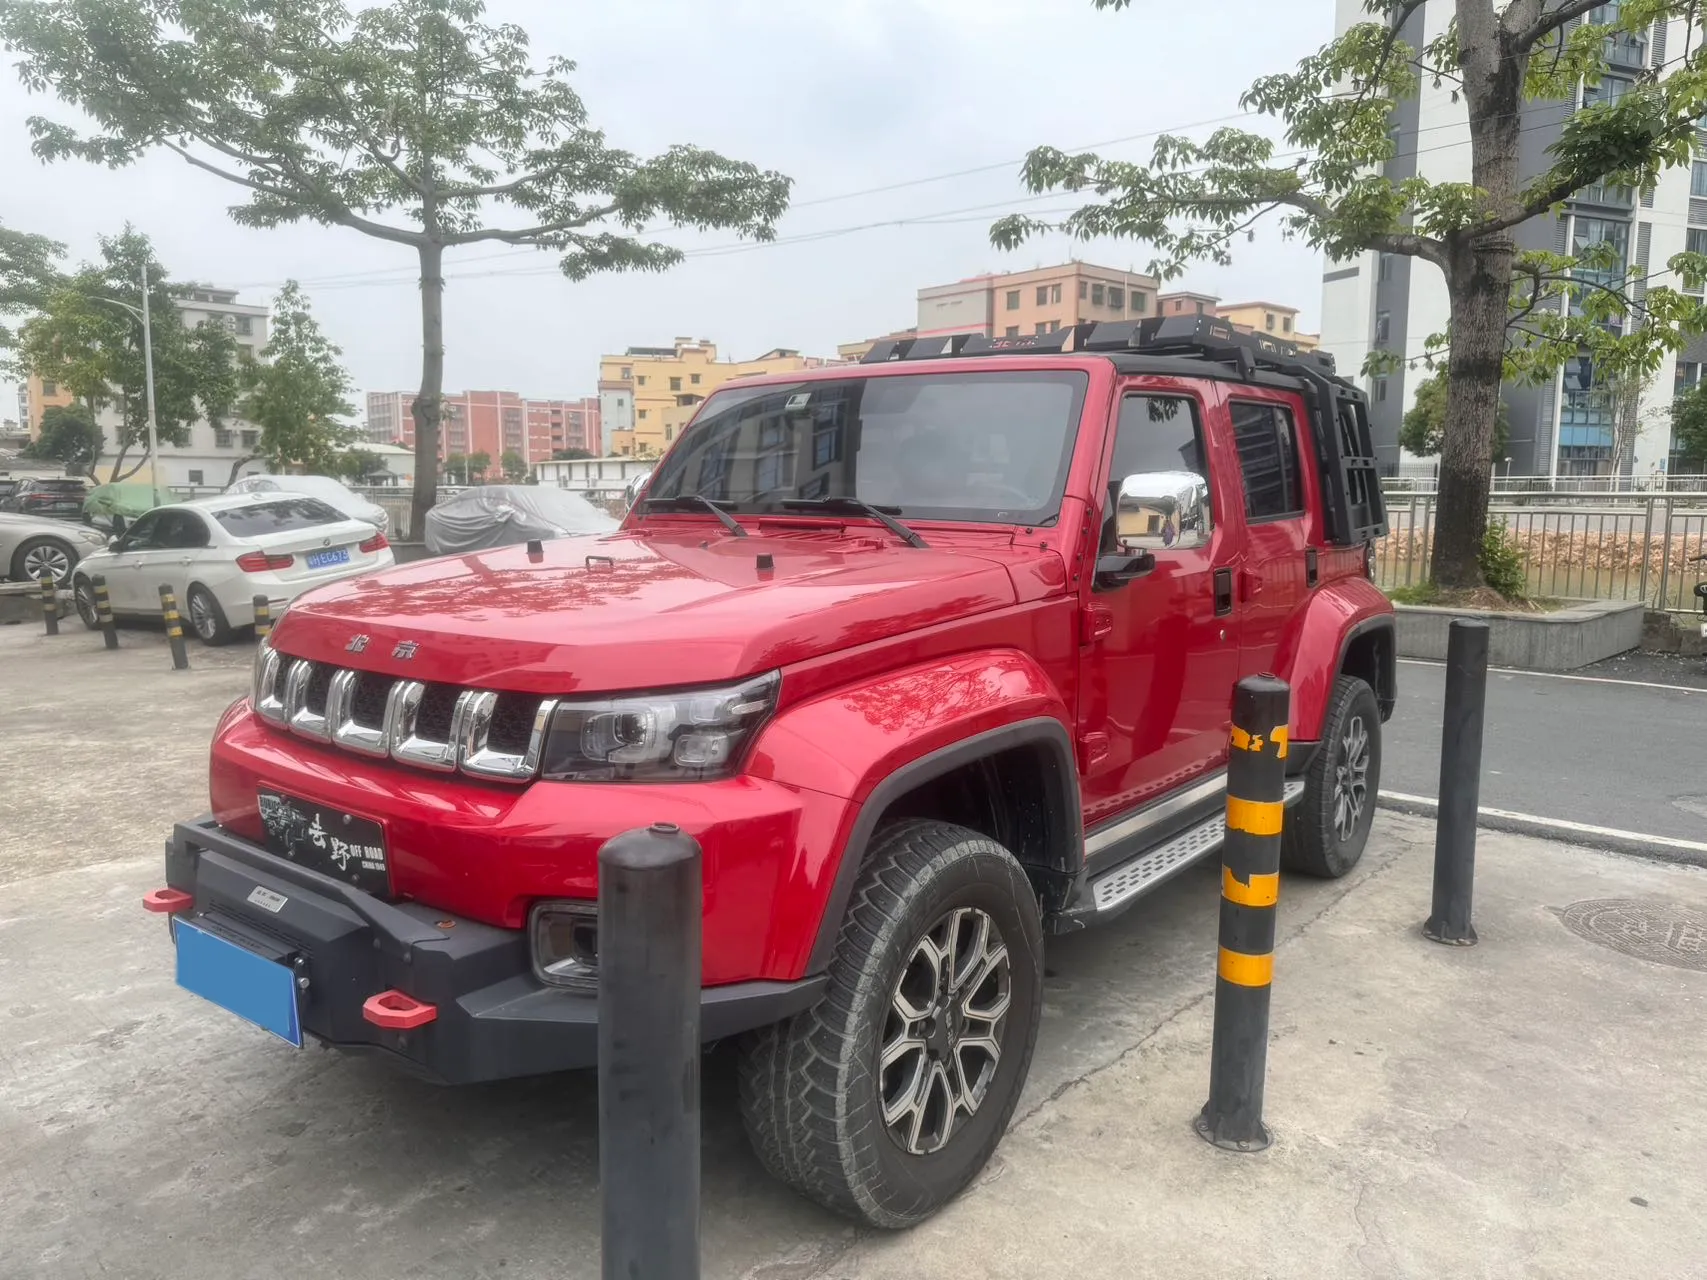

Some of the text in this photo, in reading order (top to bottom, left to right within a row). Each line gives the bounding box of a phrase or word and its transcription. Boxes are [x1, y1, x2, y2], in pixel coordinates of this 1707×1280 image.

[344, 633, 421, 661] 北京
[349, 844, 384, 861] OFF ROAD
